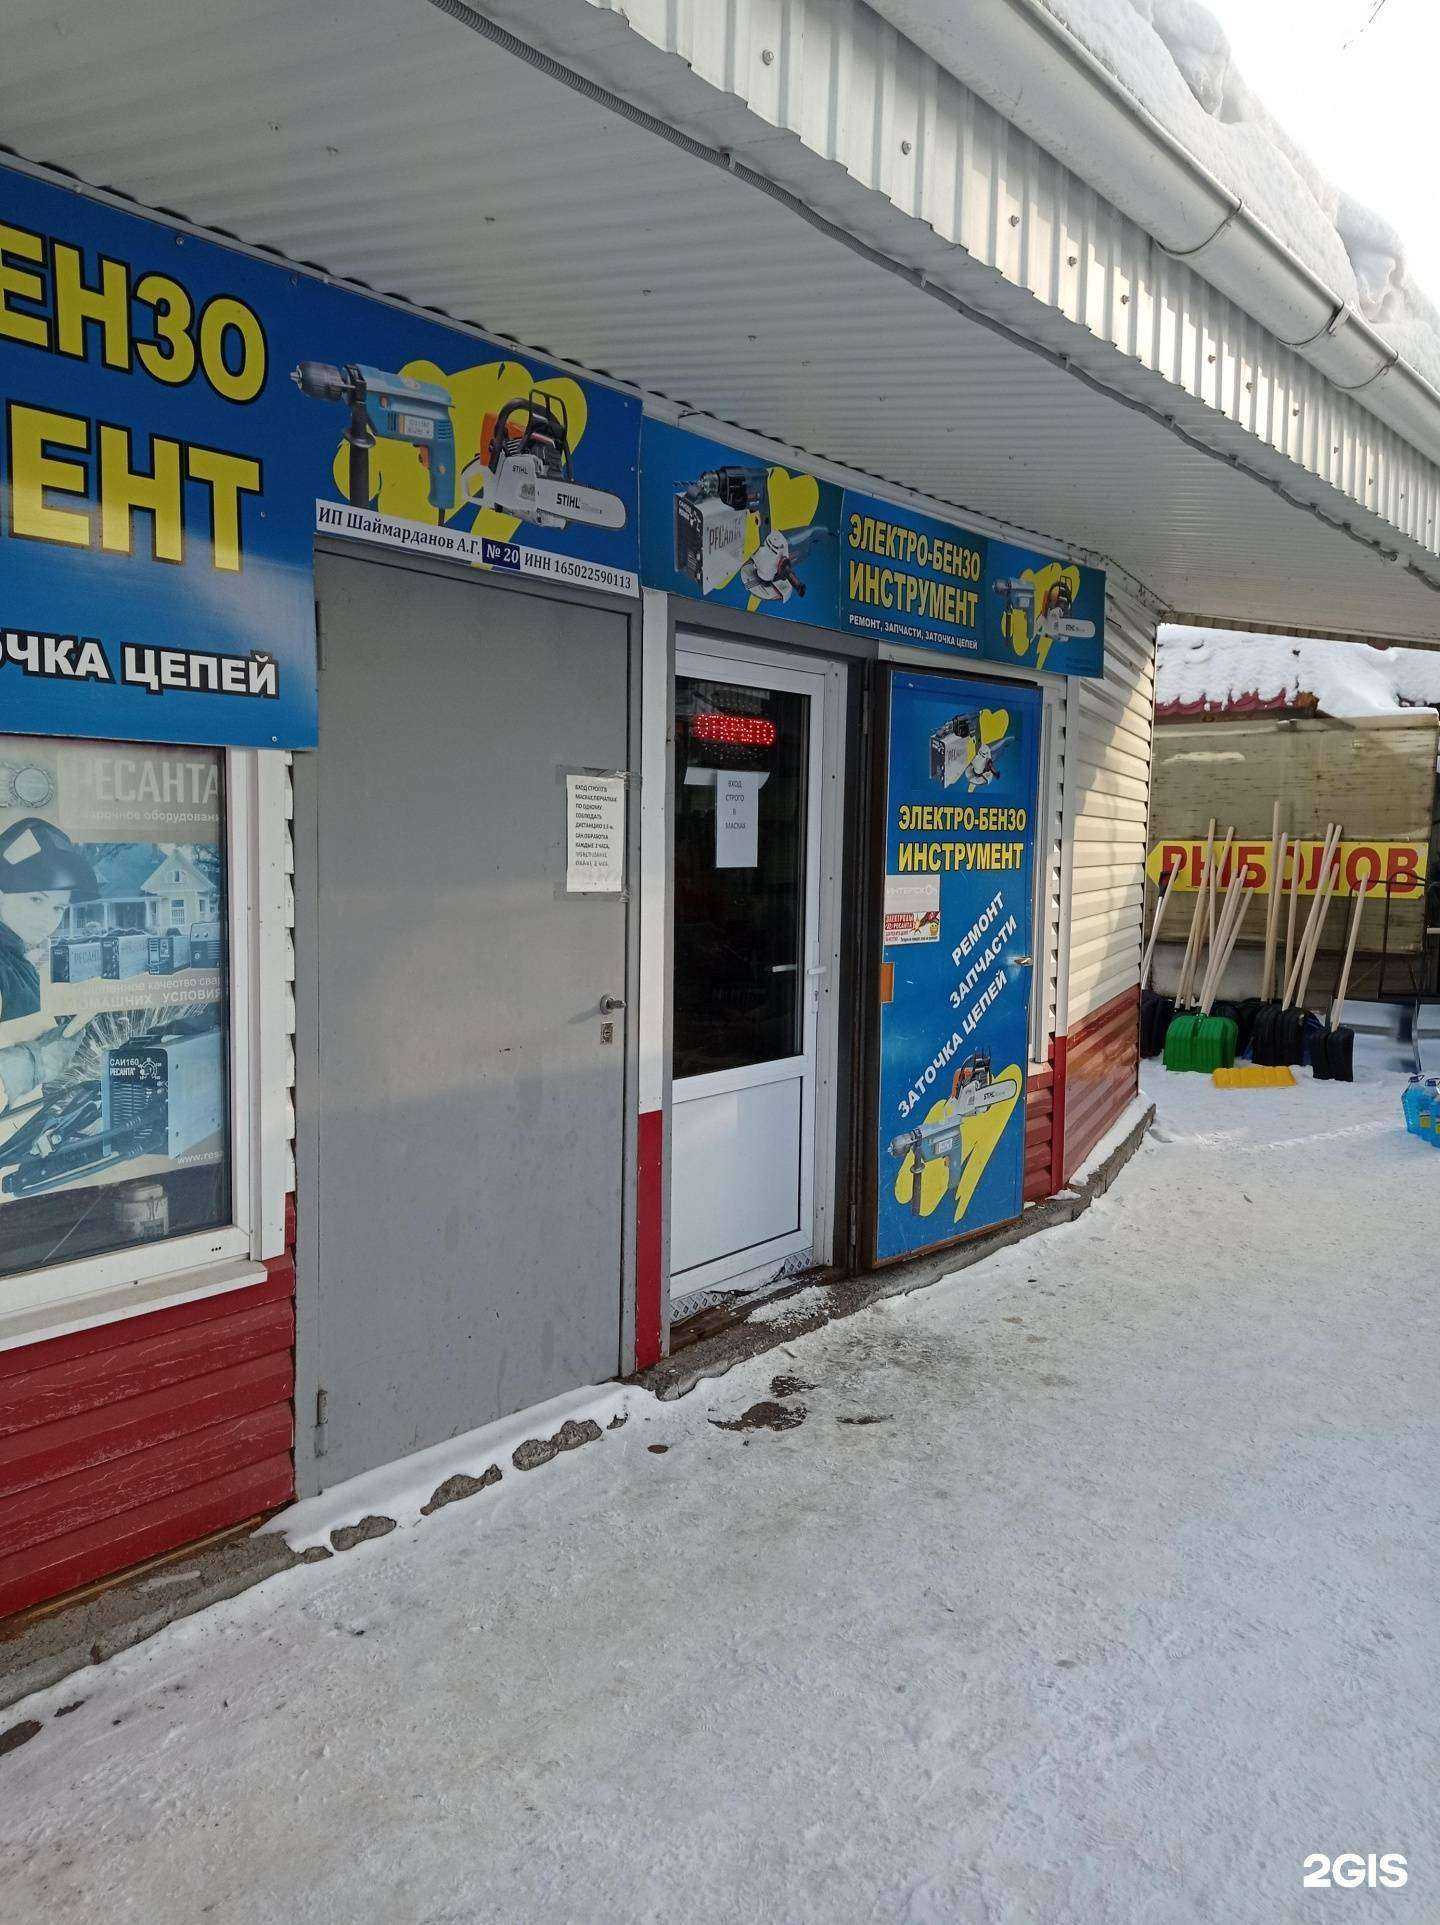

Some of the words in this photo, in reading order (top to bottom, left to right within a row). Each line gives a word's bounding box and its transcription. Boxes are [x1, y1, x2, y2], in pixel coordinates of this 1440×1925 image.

[9, 402, 262, 572] ЕНТ
[512, 464, 529, 475] STIHL
[556, 493, 581, 509] STIHL
[318, 506, 343, 526] ИП
[347, 511, 454, 549] Шаймарданов
[457, 538, 480, 555] А.Г.
[504, 547, 519, 564] 20
[524, 552, 551, 571] ИНН
[554, 560, 631, 589] 165022590113
[848, 513, 980, 581] ЭЛЕКТРО-БЕНЗО
[849, 560, 978, 628] ИНСТРУМЕНТ
[0, 632, 109, 679] ЧКА
[124, 645, 277, 695] ЦЕПЕЙ
[849, 614, 883, 633] РЕМОНТ,
[925, 631, 955, 646] ЗАТОЧКА
[956, 638, 978, 650] ЦЕПЕЙ
[898, 805, 1027, 831] ЭЛЕКТРО-БЕНЗО
[898, 842, 1024, 871] ИНСТРУМЕНТ
[950, 914, 1017, 1009] ЗАПЧАСТИ
[951, 891, 1005, 967] РЕМОНТ
[898, 1032, 964, 1118] ЗАТОЧКА
[962, 969, 1008, 1035] ЦЕПЕЙ
